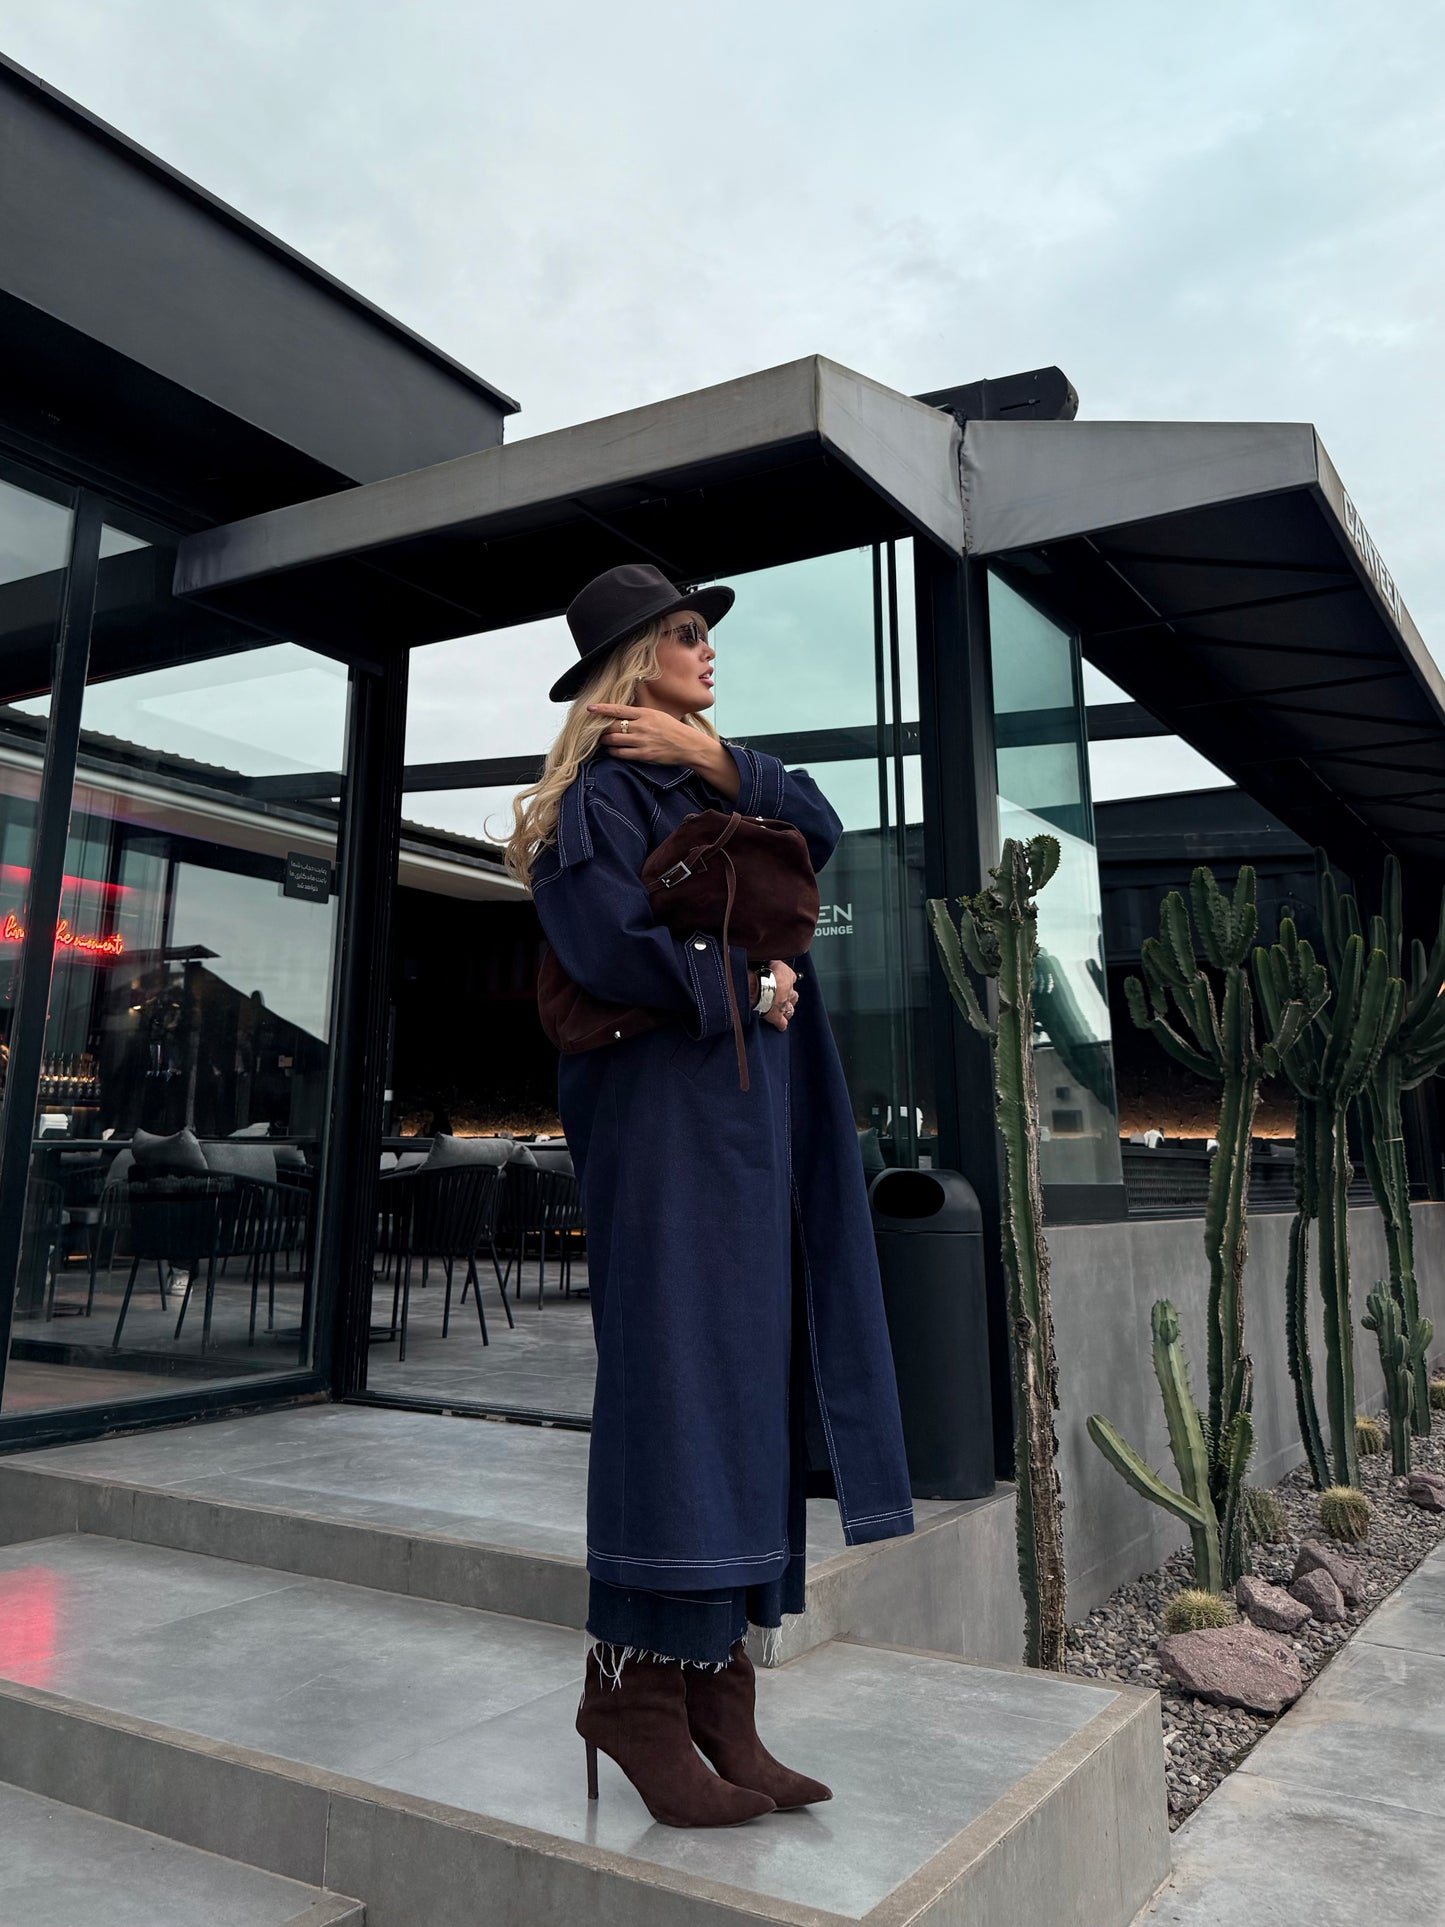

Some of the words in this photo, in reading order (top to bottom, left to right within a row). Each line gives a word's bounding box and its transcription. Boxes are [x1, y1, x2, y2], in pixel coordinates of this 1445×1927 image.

[1342, 491, 1403, 625] CANTEEN
[817, 903, 852, 924] EN
[56, 920, 74, 944] he
[813, 925, 853, 937] OUNGE
